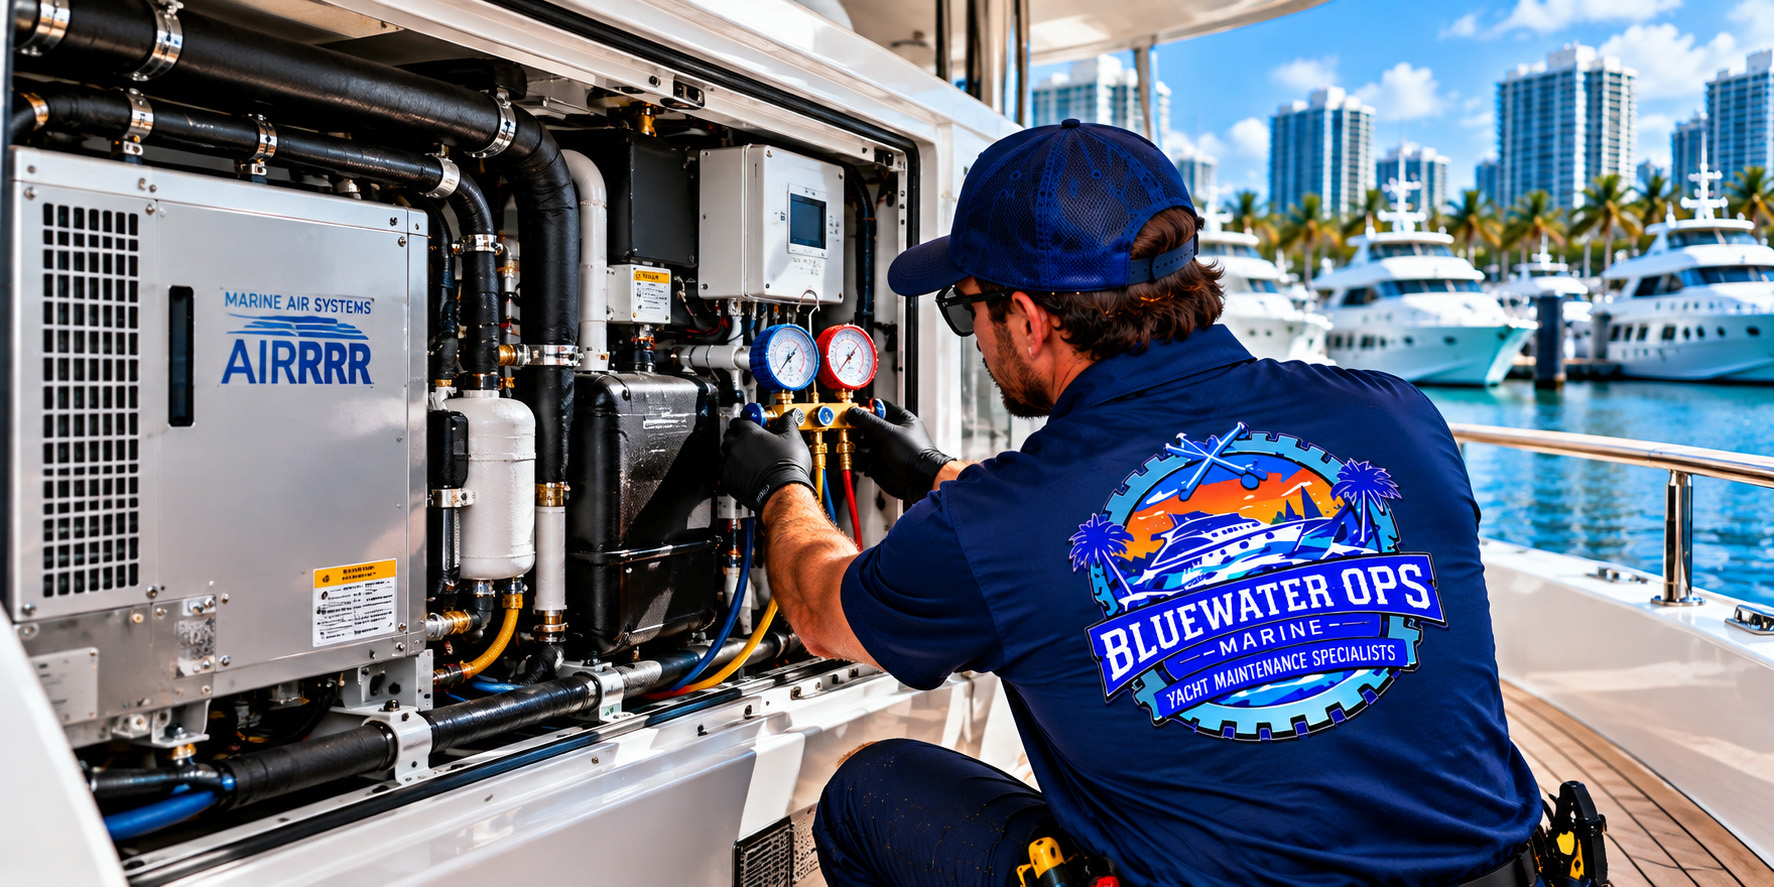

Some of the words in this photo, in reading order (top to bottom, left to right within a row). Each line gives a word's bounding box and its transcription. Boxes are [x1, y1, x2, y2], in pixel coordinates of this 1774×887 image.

[224, 291, 282, 310] MARINE
[286, 295, 310, 311] AIR
[314, 297, 371, 315] SYSTEMS
[221, 338, 372, 385] AIRRRR
[1100, 574, 1335, 682] BLUEWATER
[1341, 563, 1431, 610] OPS
[1219, 619, 1323, 656] MARINE
[1166, 677, 1209, 710] YACHT
[1213, 651, 1308, 691] MAINTENANCE
[1312, 644, 1396, 667] SPECIALISTS
